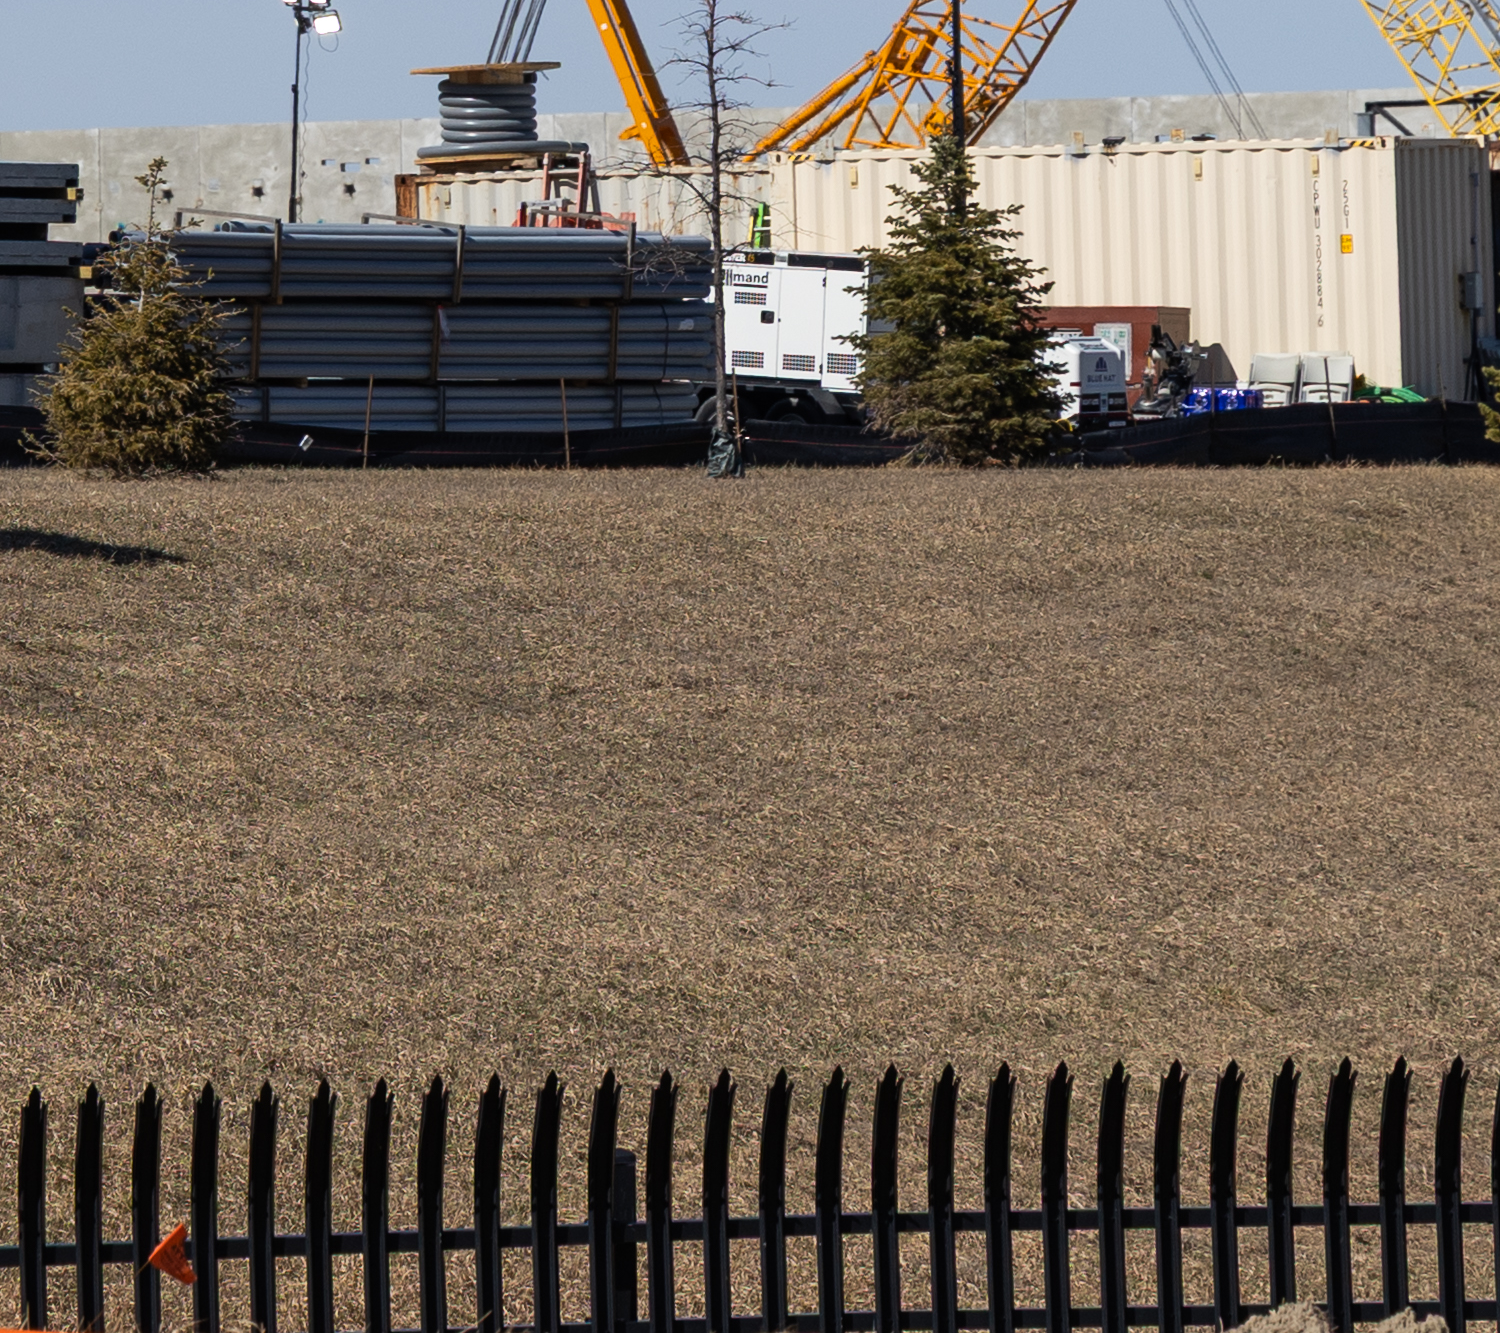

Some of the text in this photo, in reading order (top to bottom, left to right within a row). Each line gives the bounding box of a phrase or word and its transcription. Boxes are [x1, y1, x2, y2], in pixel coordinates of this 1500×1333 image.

[1312, 180, 1321, 229] CPWU
[724, 269, 769, 286] llmand
[1315, 234, 1323, 309] 302884
